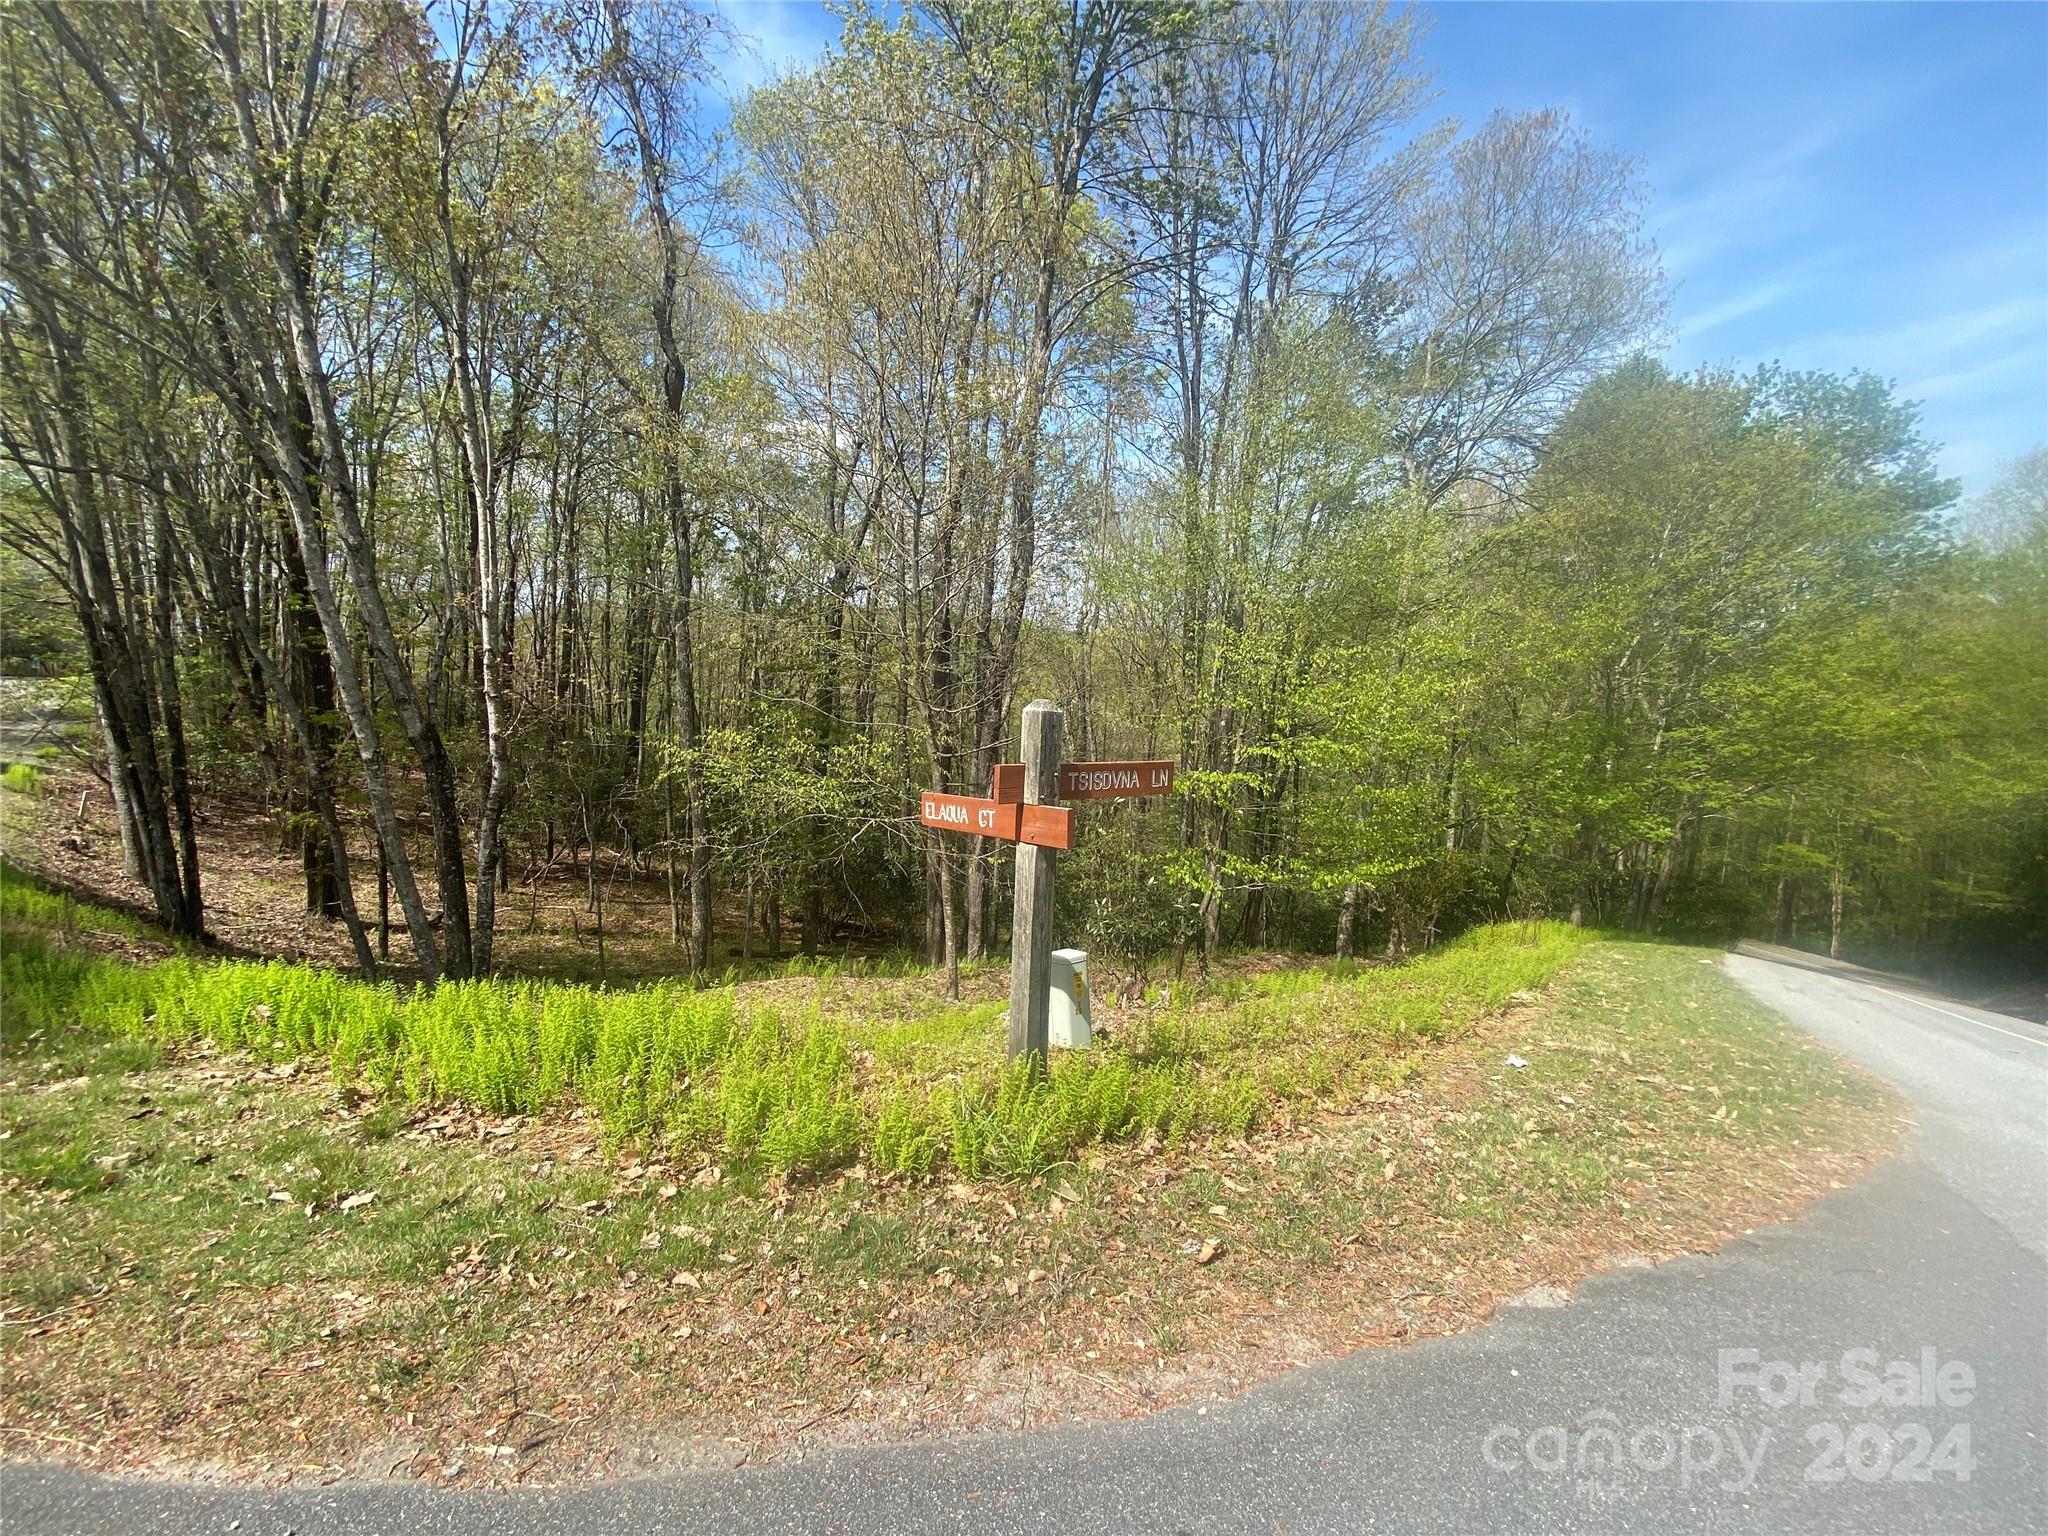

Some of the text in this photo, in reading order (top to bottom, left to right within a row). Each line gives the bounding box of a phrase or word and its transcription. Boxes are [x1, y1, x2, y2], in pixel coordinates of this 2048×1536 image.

[1068, 768, 1169, 791] TSISDVNA LN
[924, 802, 996, 829] ELAQUA CT
